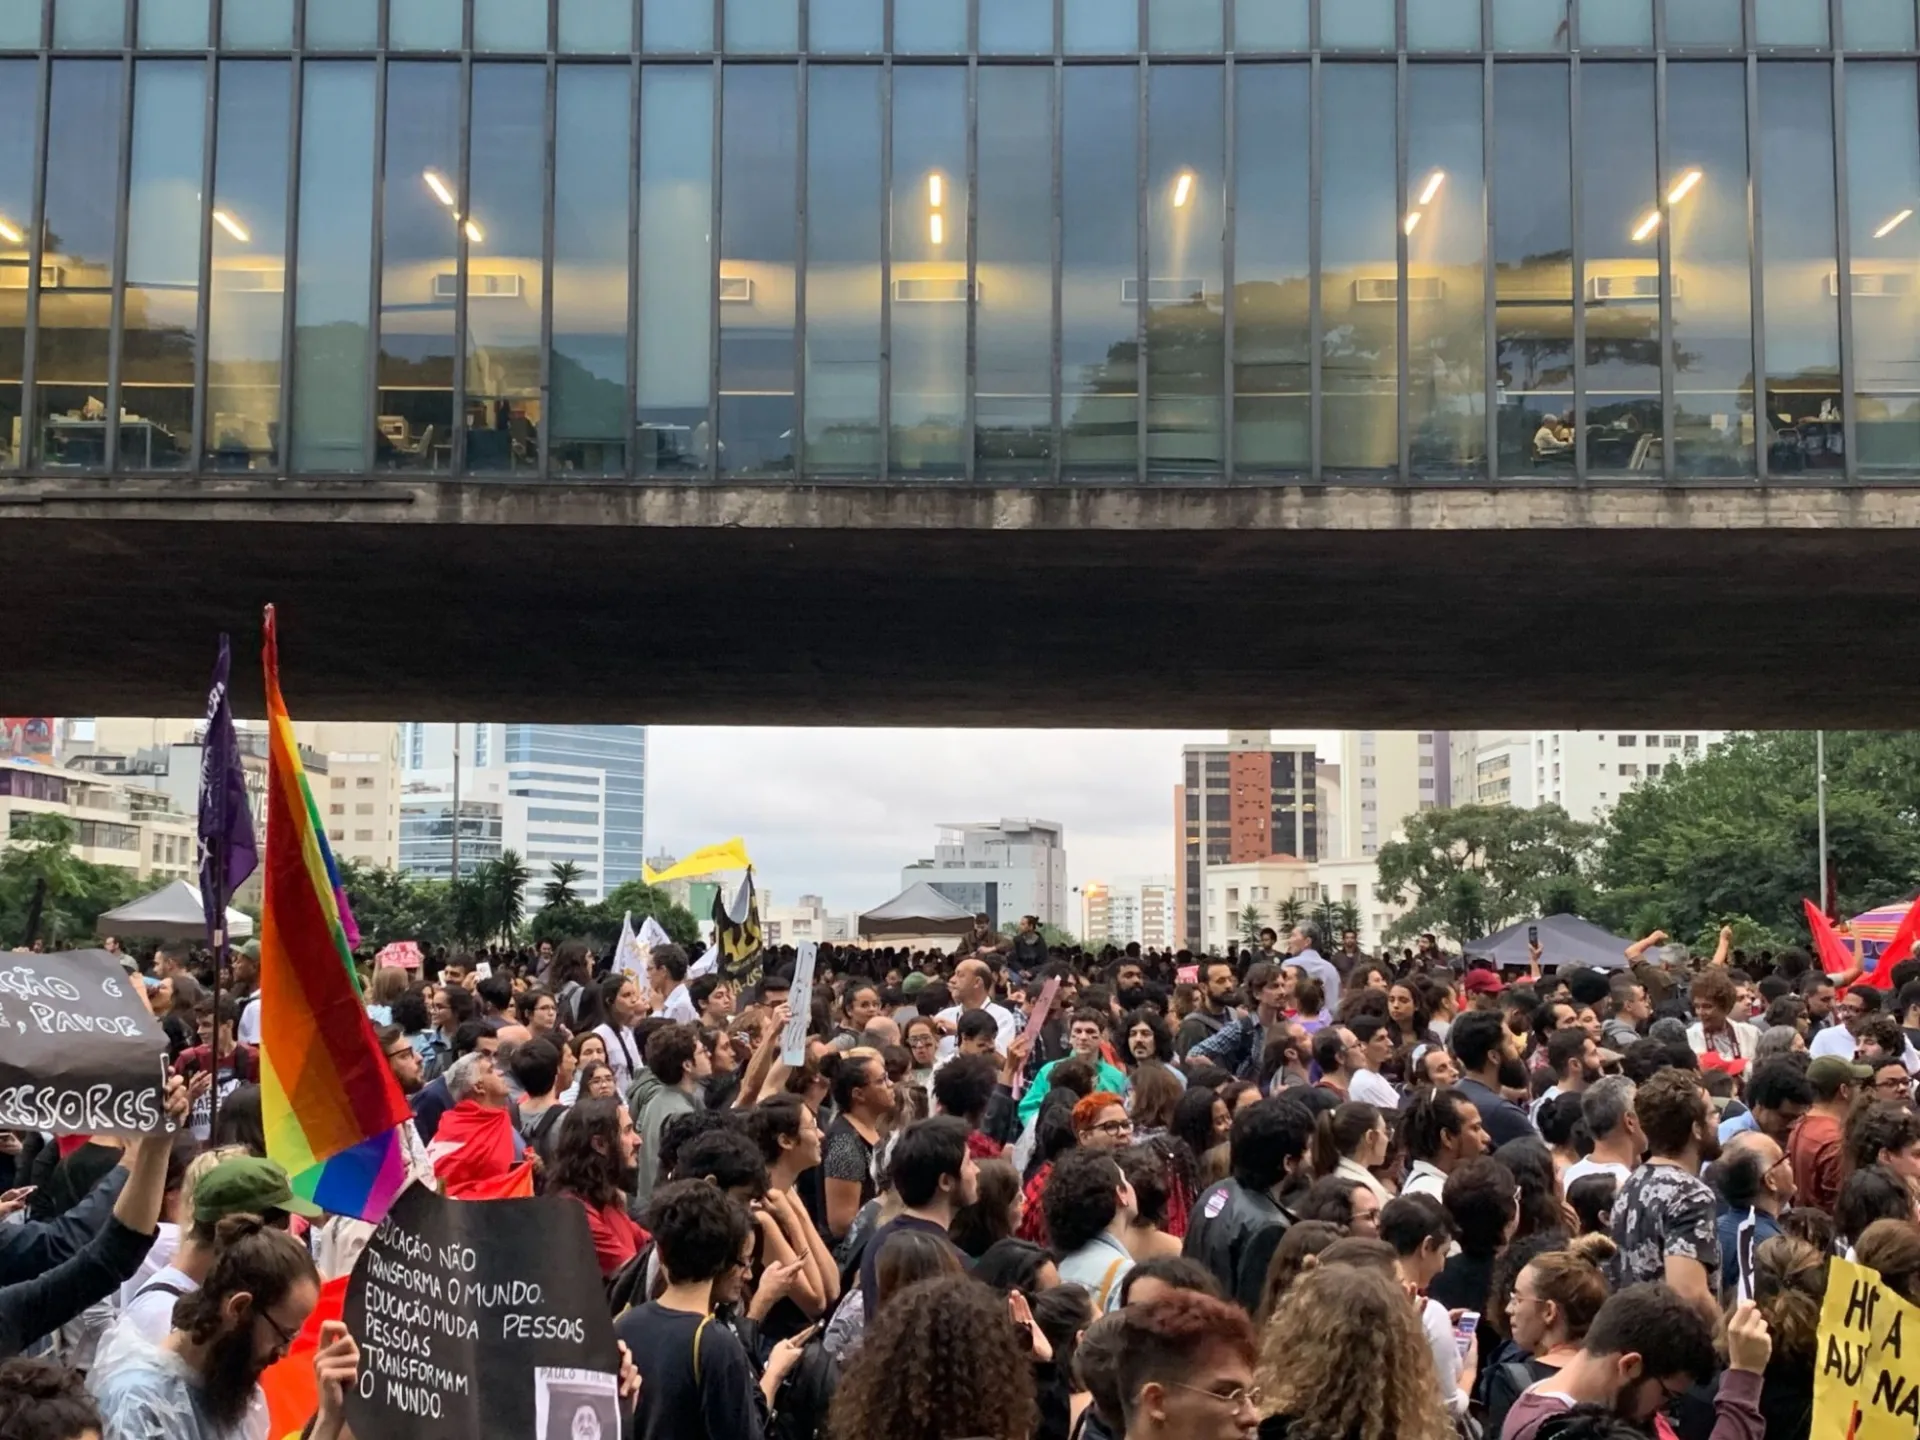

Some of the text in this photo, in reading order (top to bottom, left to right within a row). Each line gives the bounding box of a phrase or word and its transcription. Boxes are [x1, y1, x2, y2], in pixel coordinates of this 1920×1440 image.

[0, 966, 80, 1001] ÇÃO
[29, 1002, 143, 1037] PAVOR
[0, 1053, 176, 1133] ESSORES!
[366, 1247, 545, 1308] TRANSFORMA O MUNDO.
[439, 1242, 476, 1272] NÃO
[365, 1282, 585, 1344] EDUCAÇÃO MUDA PESSOAS
[365, 1312, 431, 1357] PESSOAS
[360, 1369, 374, 1398] O
[362, 1343, 469, 1396] TRANSFORMAM
[1824, 1333, 1872, 1387] AU
